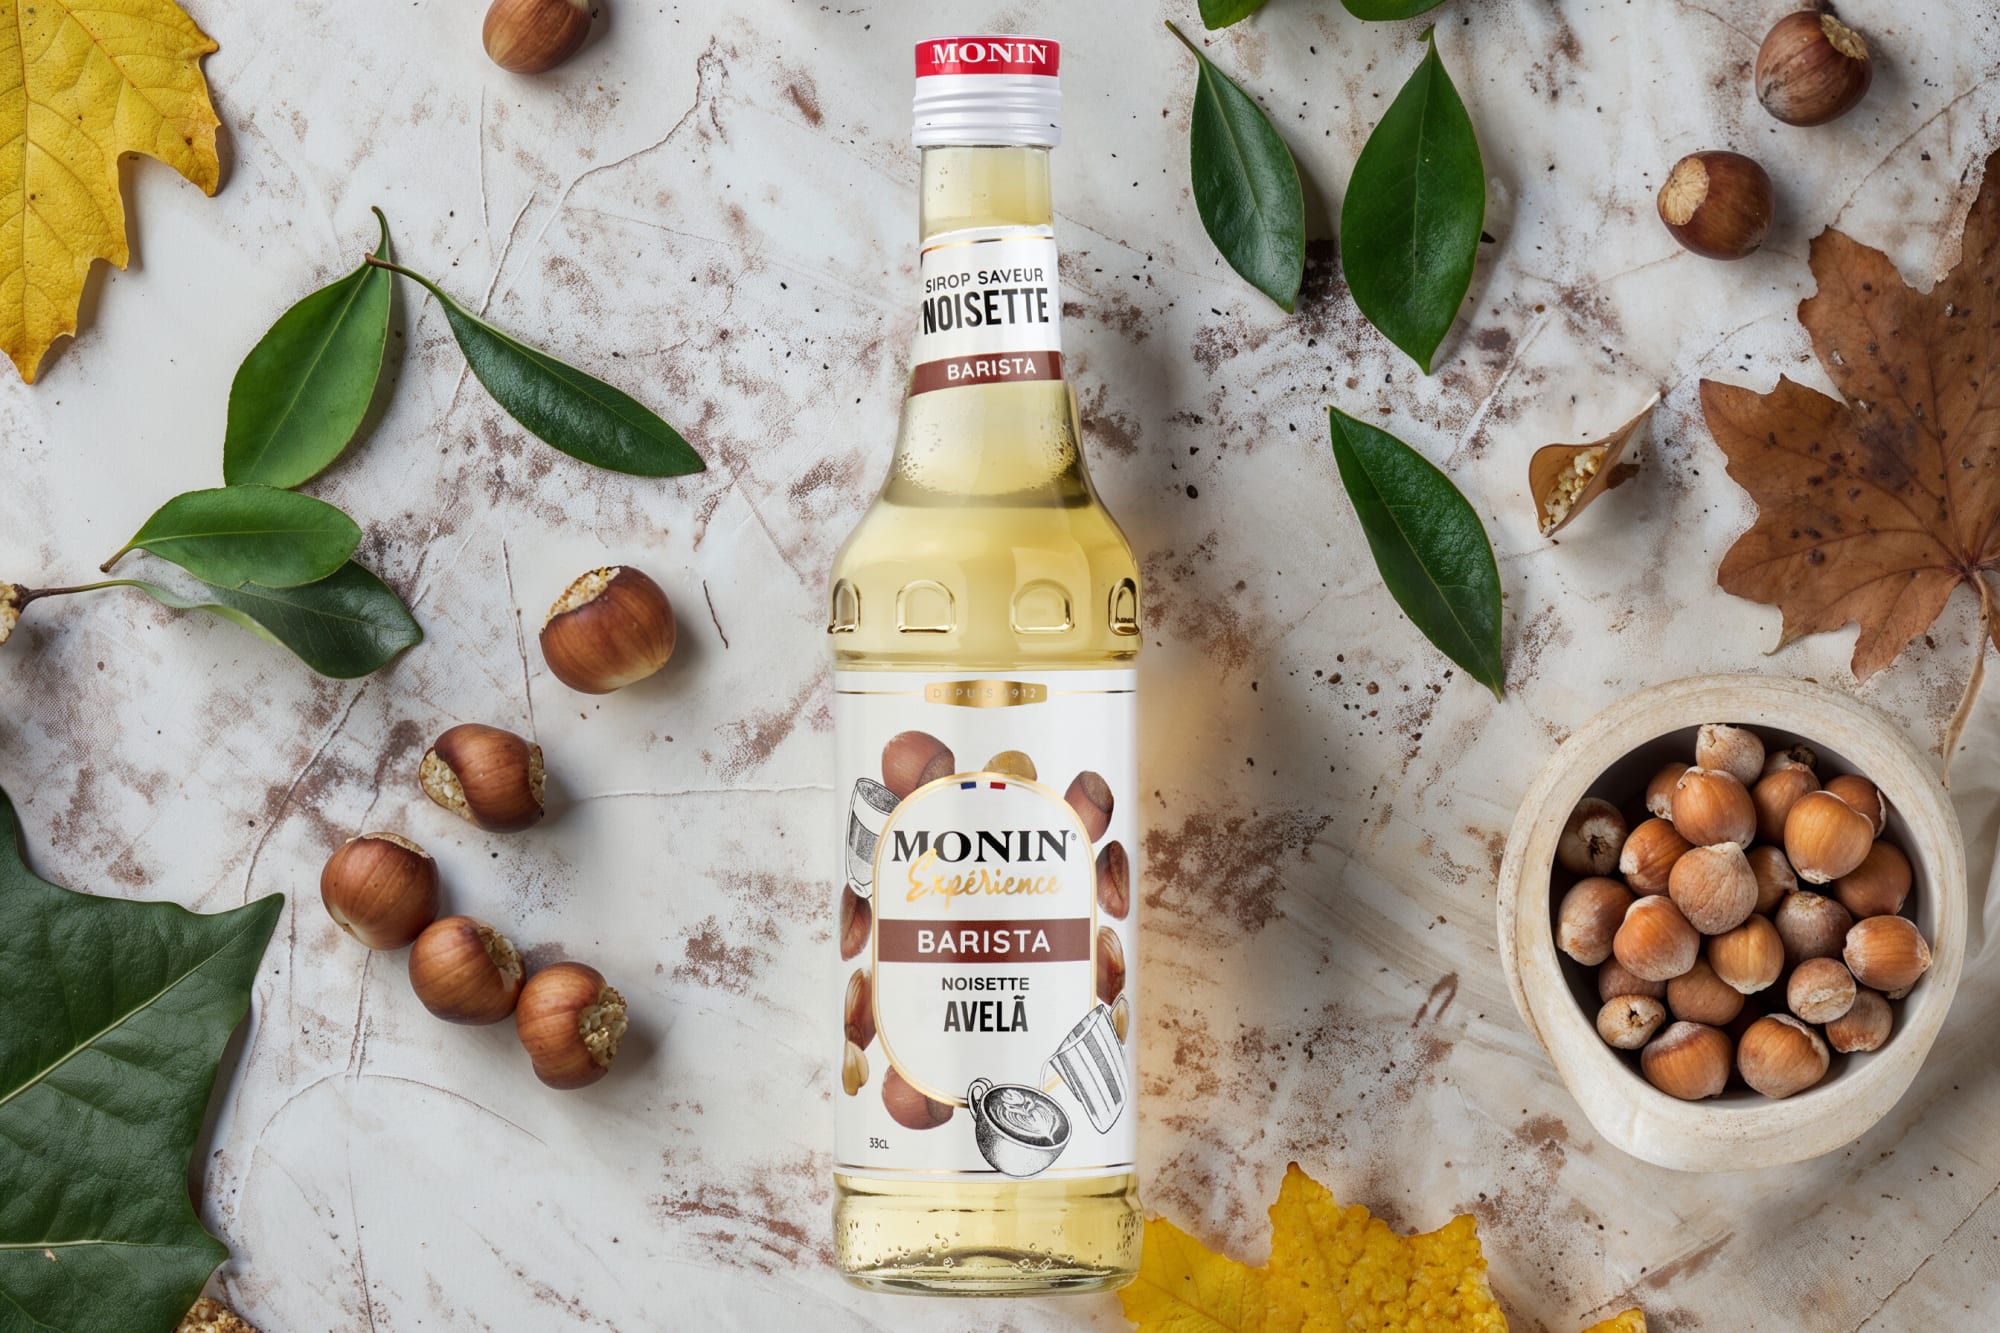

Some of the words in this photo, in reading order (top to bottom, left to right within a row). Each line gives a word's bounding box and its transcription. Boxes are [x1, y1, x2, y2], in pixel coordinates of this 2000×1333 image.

[932, 43, 1048, 65] MONIN
[925, 273, 971, 294] SIROP
[978, 268, 1044, 285] SAVEUR
[923, 287, 1049, 336] NOISETTE
[947, 358, 1037, 380] BARISTA
[905, 849, 1062, 912] Expérience
[918, 930, 1051, 954] BARISTA
[941, 977, 1030, 991] NOISETTE
[944, 995, 1028, 1033] AVELÃ
[869, 1137, 890, 1150] 33CL
